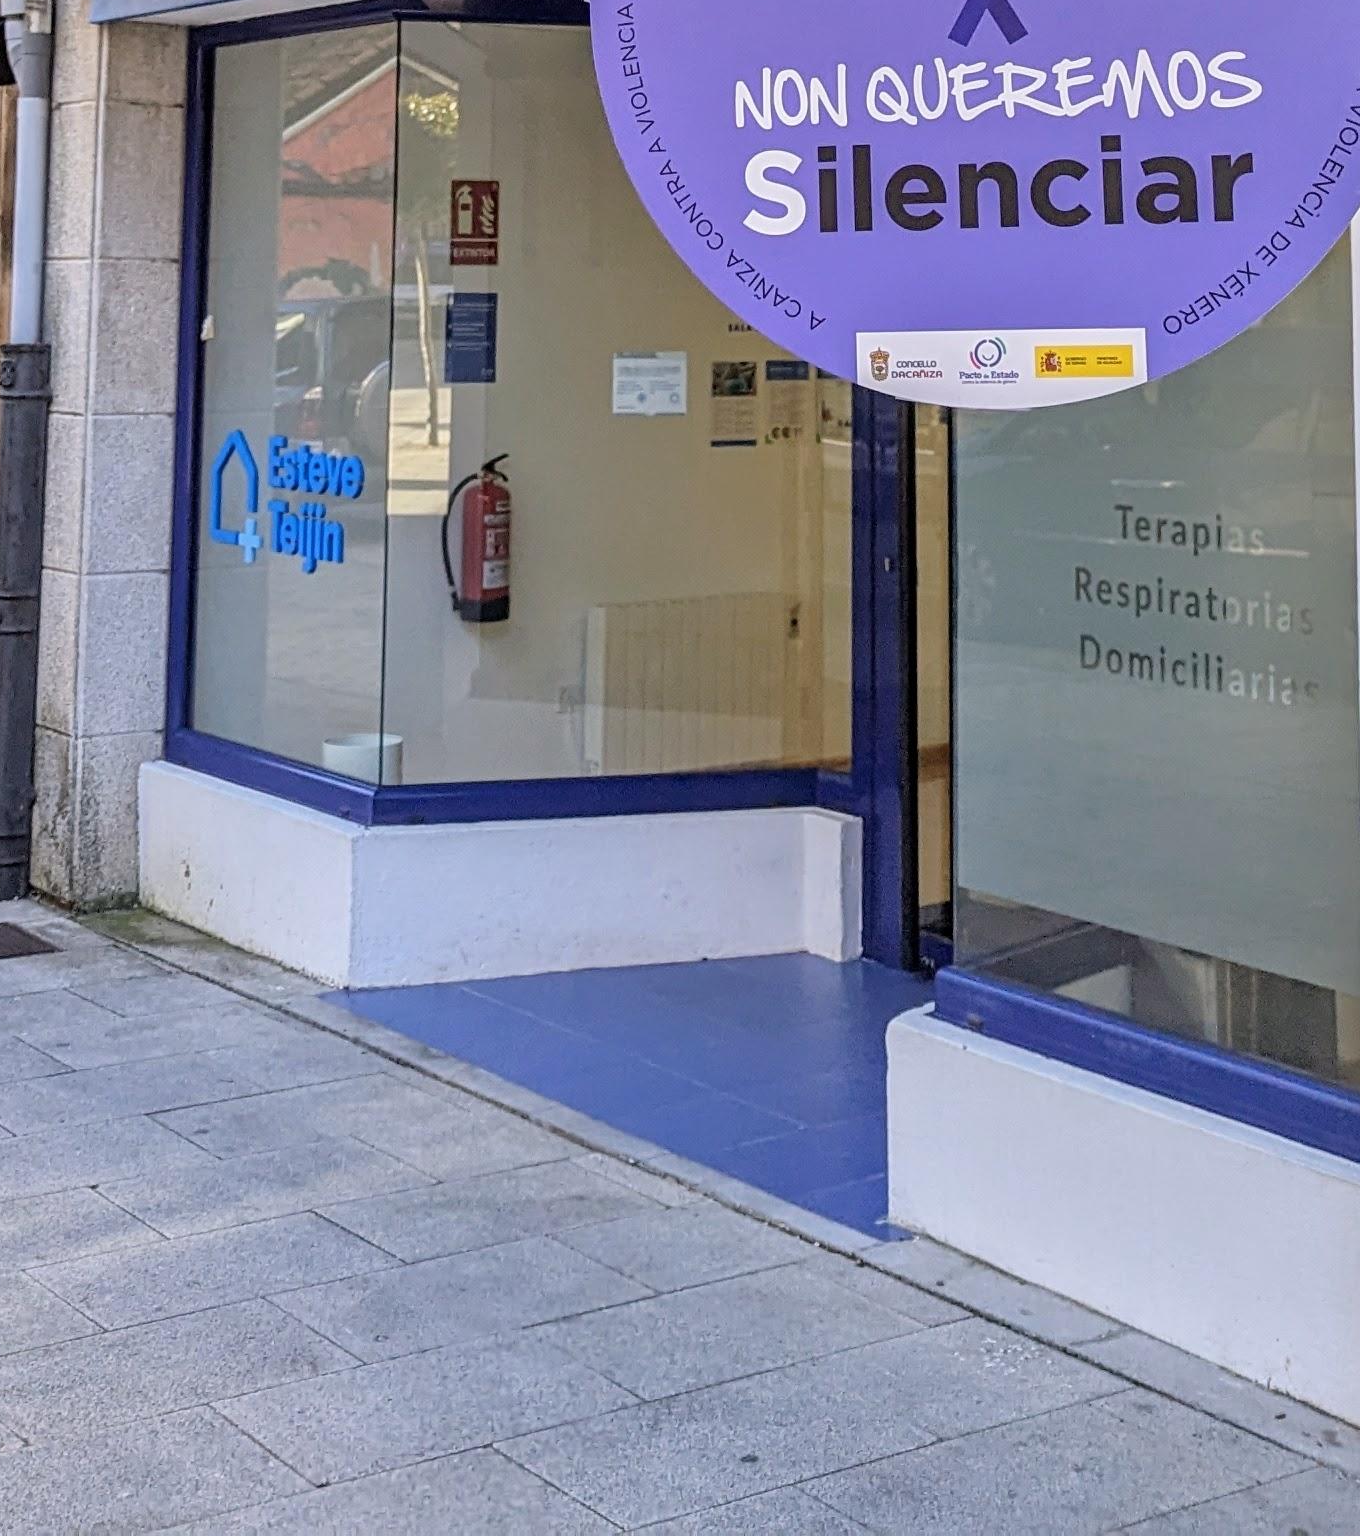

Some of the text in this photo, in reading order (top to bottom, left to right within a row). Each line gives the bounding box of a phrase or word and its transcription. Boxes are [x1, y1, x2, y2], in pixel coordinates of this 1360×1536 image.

[616, 2, 655, 135] VIOLENCIA
[734, 48, 1265, 131] NON QUEREMOS
[648, 136, 667, 154] A
[659, 160, 724, 250] CONTRA
[741, 134, 1255, 236] Silenciar
[726, 249, 803, 319] CAÑIZA
[1255, 230, 1293, 268] DE
[810, 311, 827, 331] A
[1162, 261, 1262, 336] XÉNERO
[959, 370, 982, 380] Pacto
[990, 370, 1020, 380] Estado
[268, 435, 365, 499] Esteve
[267, 499, 344, 574] Teijin
[1113, 503, 1265, 556] Terapias
[1073, 566, 1314, 636] Respiratorias
[1079, 633, 1320, 706] Domiciliarias
